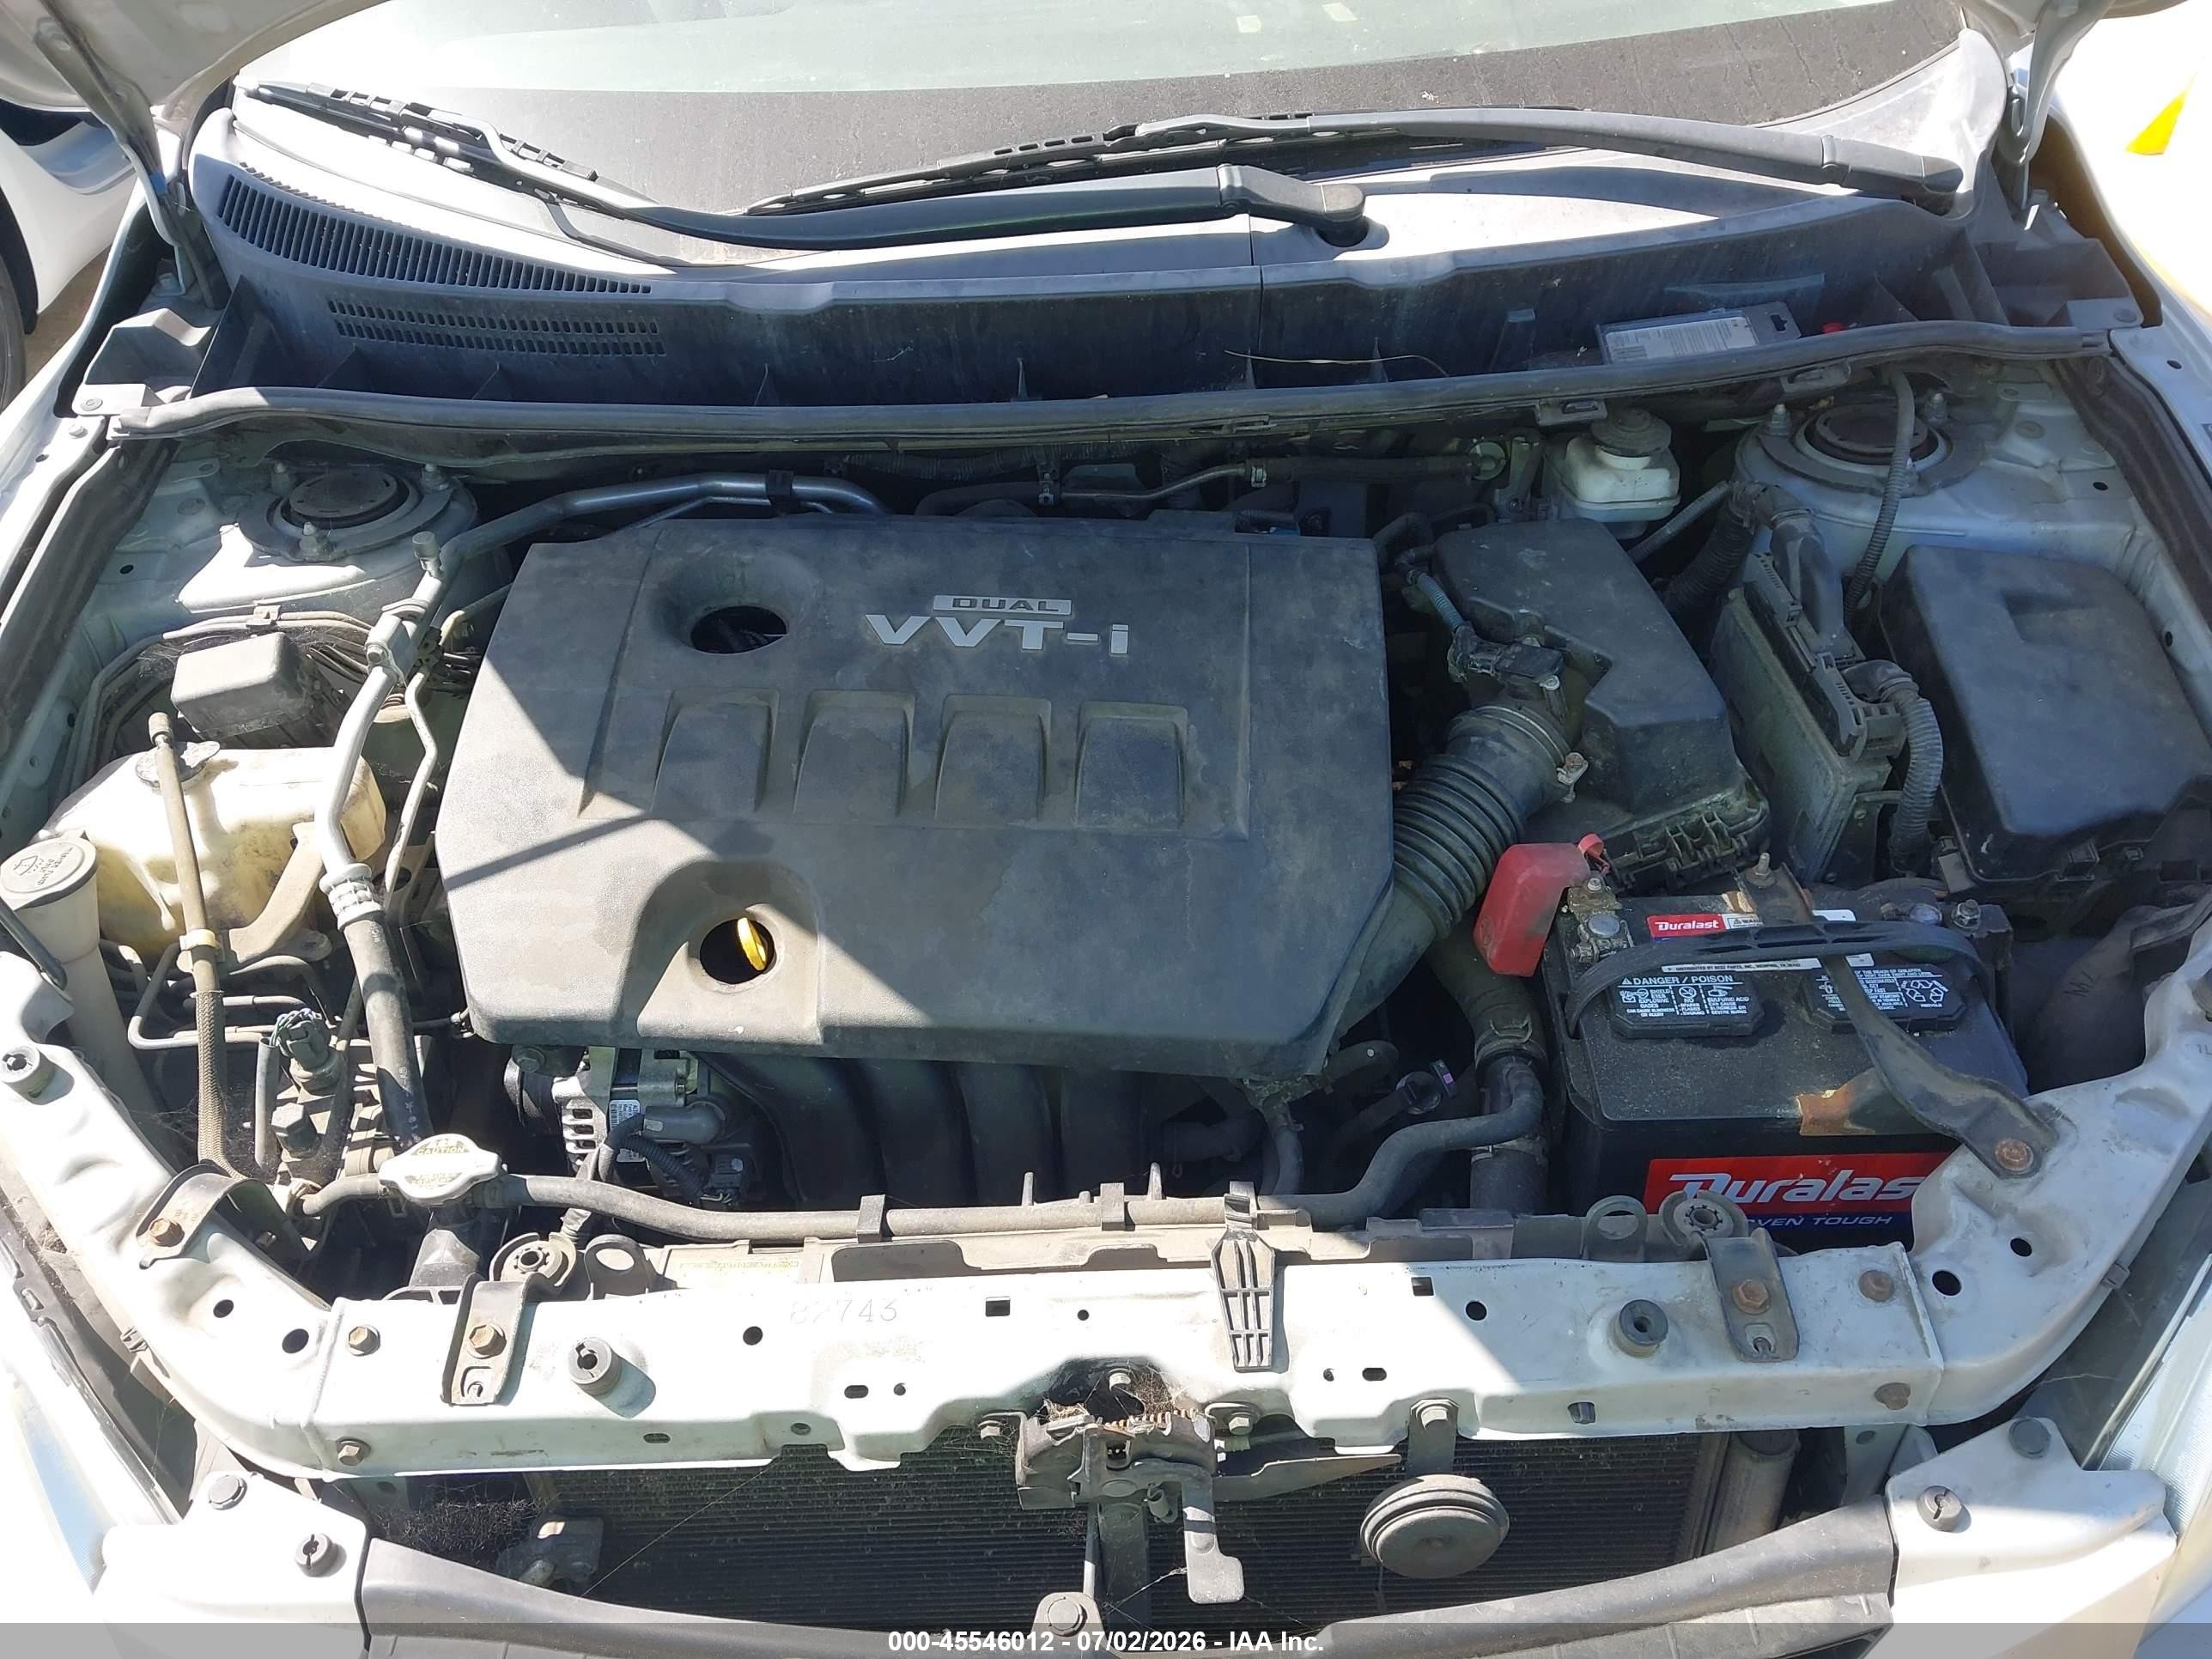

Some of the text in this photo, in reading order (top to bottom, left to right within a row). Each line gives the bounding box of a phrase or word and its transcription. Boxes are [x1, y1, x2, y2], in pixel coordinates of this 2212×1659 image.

[952, 598, 1060, 612] DUAL
[865, 614, 1129, 655] VVT-i
[1655, 920, 1719, 931] Duralast
[1633, 976, 1680, 985] DANGER
[1691, 975, 1734, 983] POISON
[416, 1146, 465, 1155] CAUTION
[1669, 1170, 1927, 1203] Duralas
[1814, 1216, 1893, 1225] TOUGH
